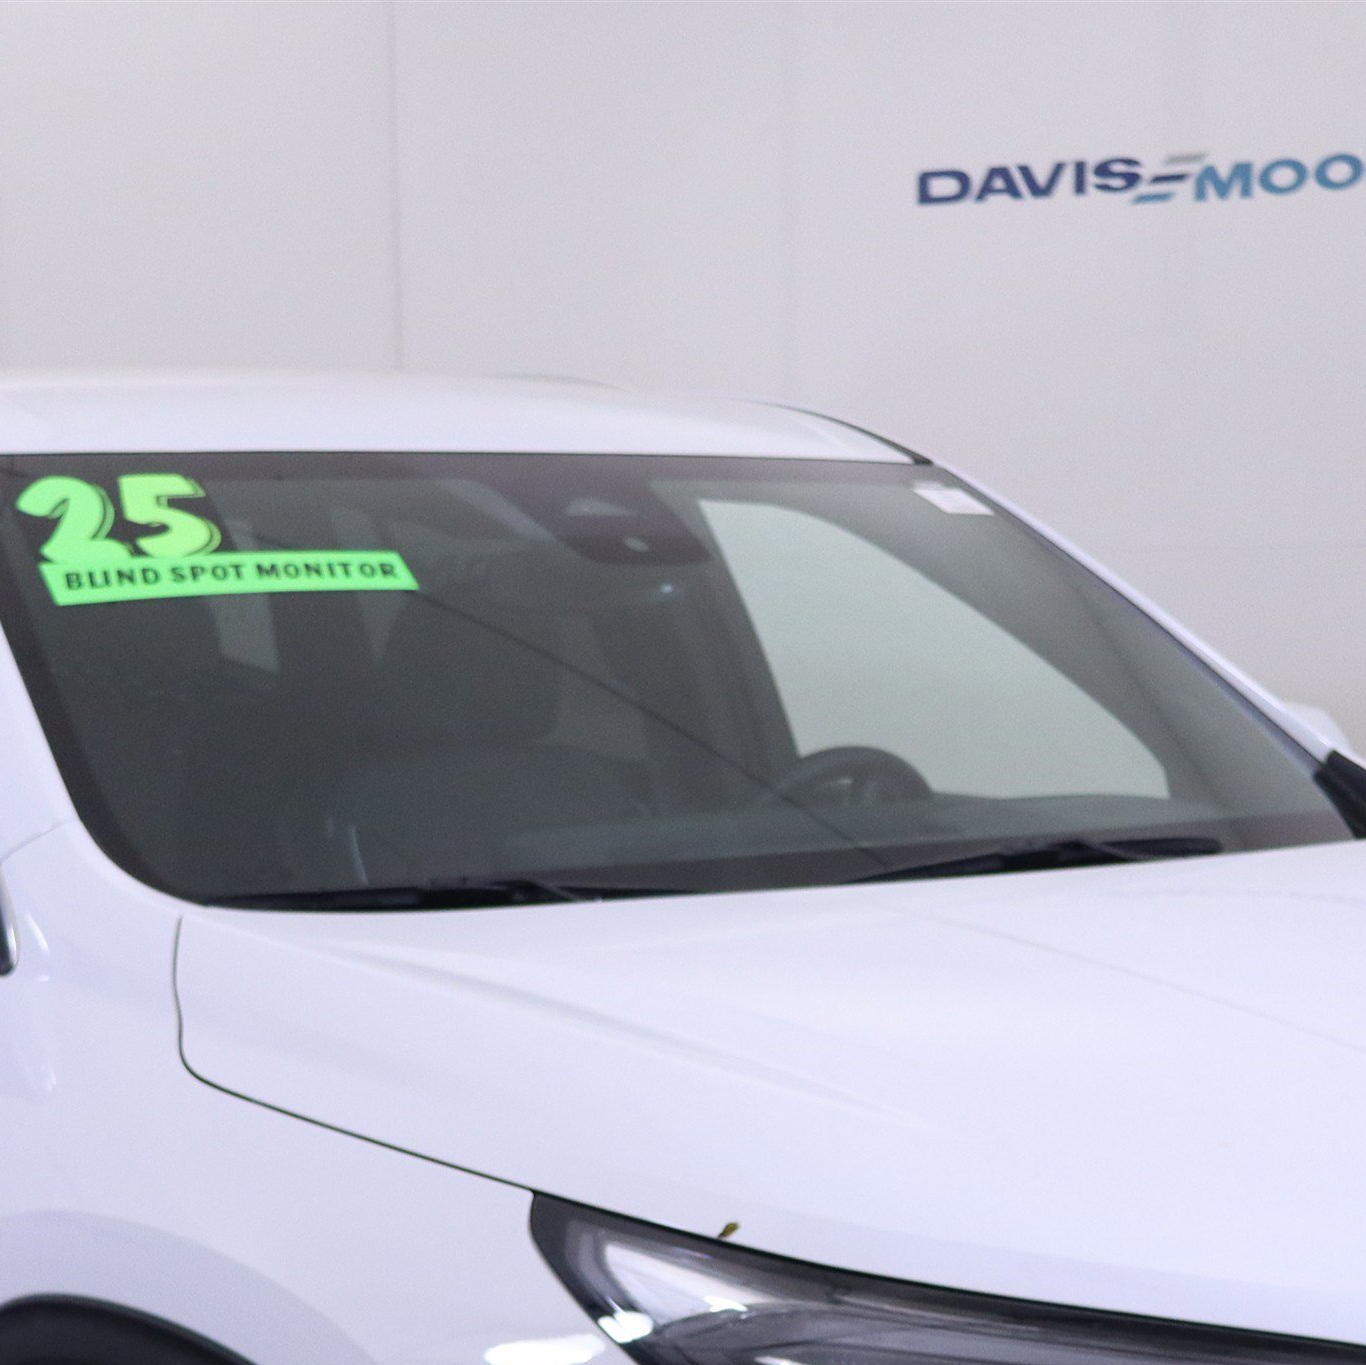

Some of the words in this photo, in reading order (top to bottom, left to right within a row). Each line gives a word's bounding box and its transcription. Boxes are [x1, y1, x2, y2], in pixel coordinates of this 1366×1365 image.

[917, 157, 1140, 206] DAVIS
[16, 473, 222, 565] 25
[65, 566, 161, 591] BLIND
[171, 564, 244, 584] SPOT
[256, 562, 399, 581] MONITOR
